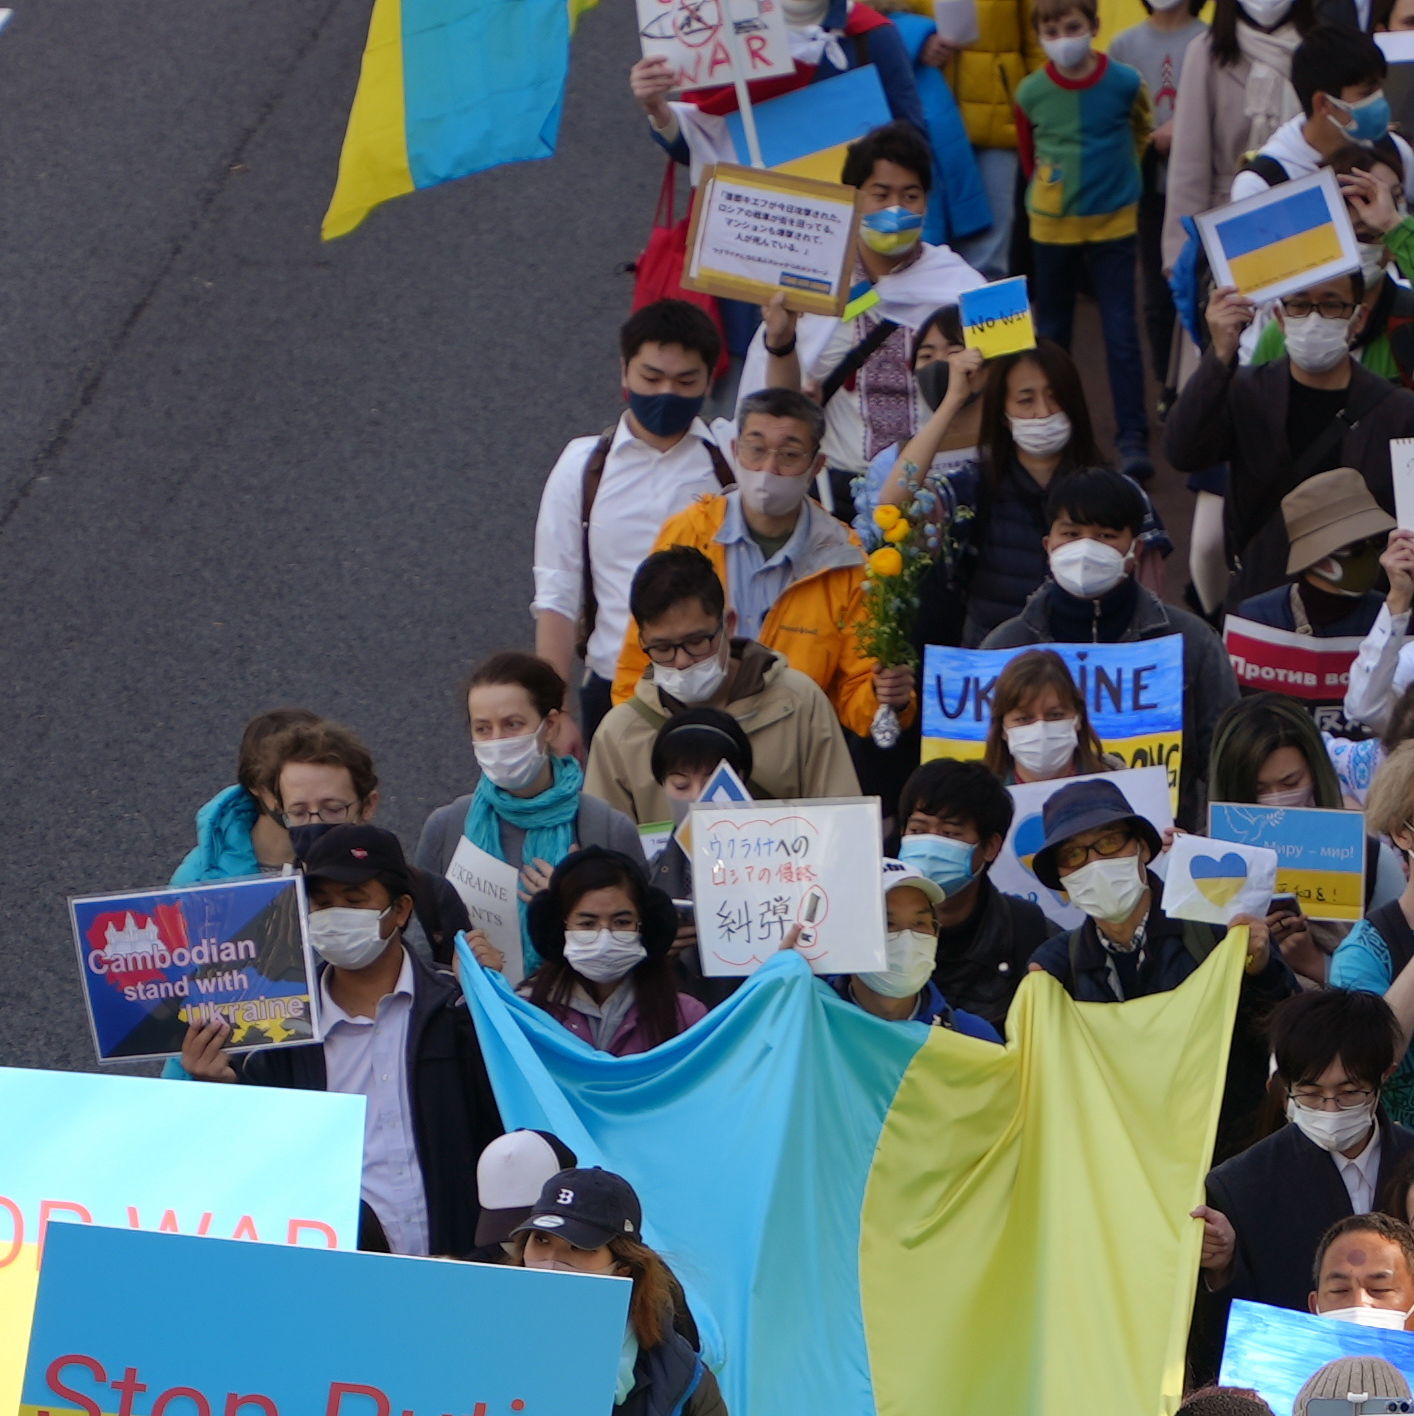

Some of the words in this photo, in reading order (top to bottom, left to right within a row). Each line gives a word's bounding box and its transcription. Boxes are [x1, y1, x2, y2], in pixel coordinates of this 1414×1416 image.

[936, 652, 1161, 723] UKINE
[708, 834, 810, 859] ウクライナへの
[450, 861, 508, 902] UKRAINE
[711, 861, 819, 886] ロシアの侵略
[87, 937, 257, 976] Cambodian
[123, 974, 190, 1002] stand
[194, 970, 249, 995] with
[186, 995, 305, 1027] Ukraine
